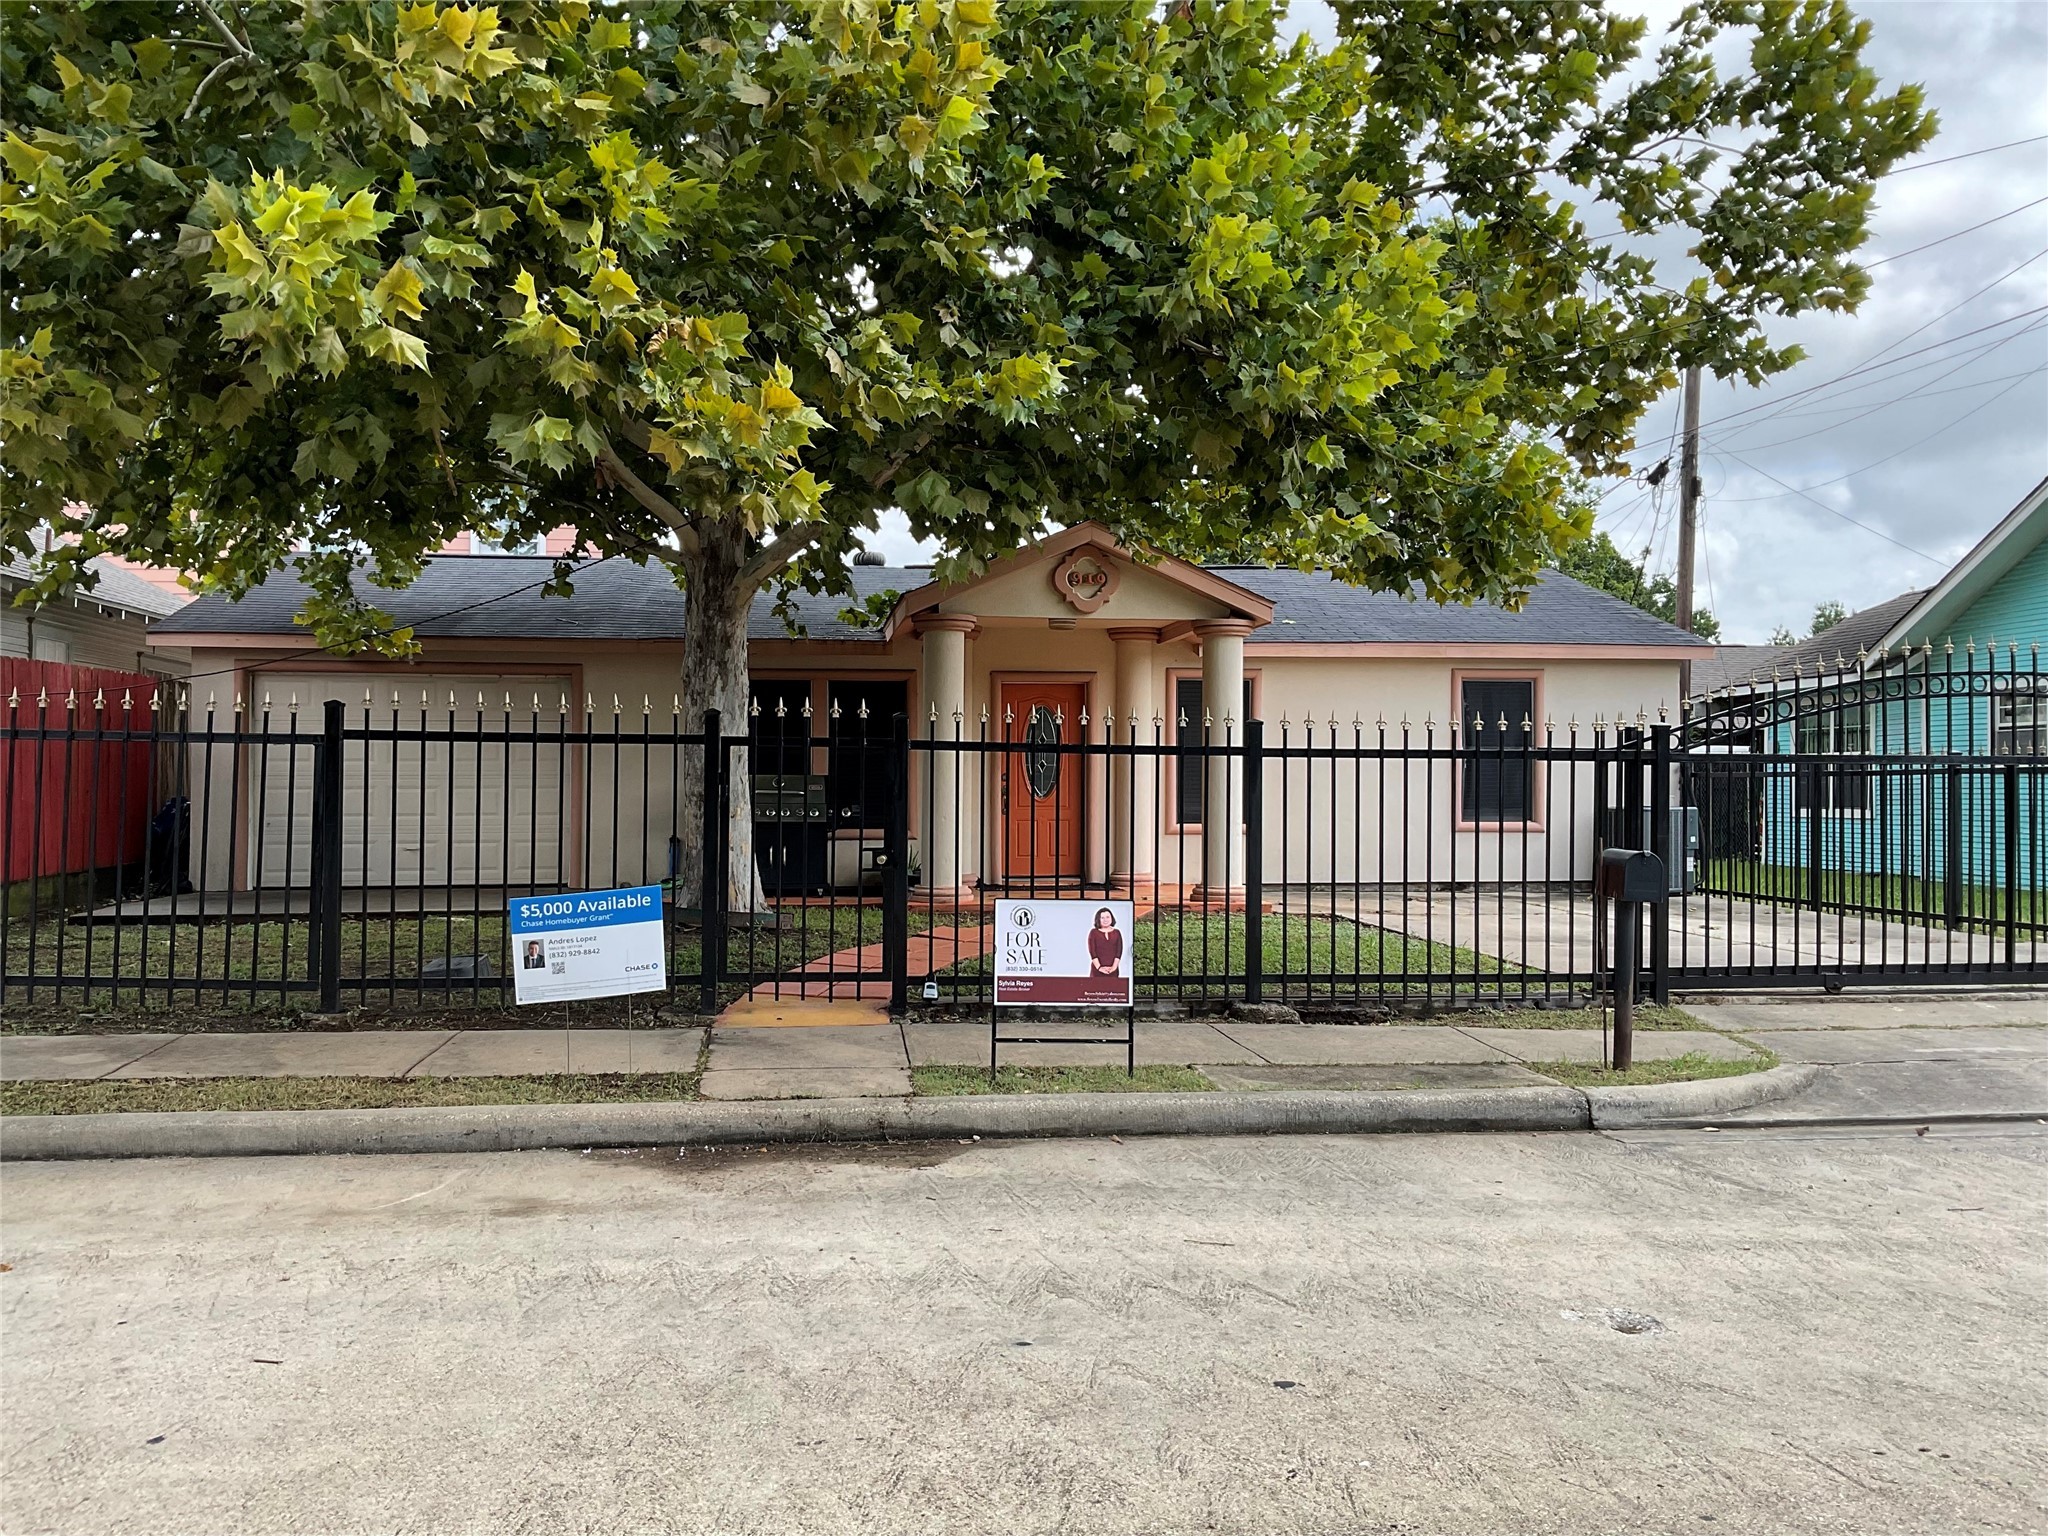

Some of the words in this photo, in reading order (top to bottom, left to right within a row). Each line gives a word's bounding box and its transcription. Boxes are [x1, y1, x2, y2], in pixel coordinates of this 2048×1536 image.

[1071, 572, 1106, 585] 910
[520, 902, 573, 918] $5,000
[577, 894, 651, 913] Available
[520, 920, 544, 928] Chase
[545, 916, 588, 925] Homebuyer
[1006, 932, 1041, 947] FOR
[549, 951, 567, 959] (832)
[568, 947, 600, 957] 929-8842
[1006, 948, 1047, 965] SALE
[624, 964, 651, 972] CHASE
